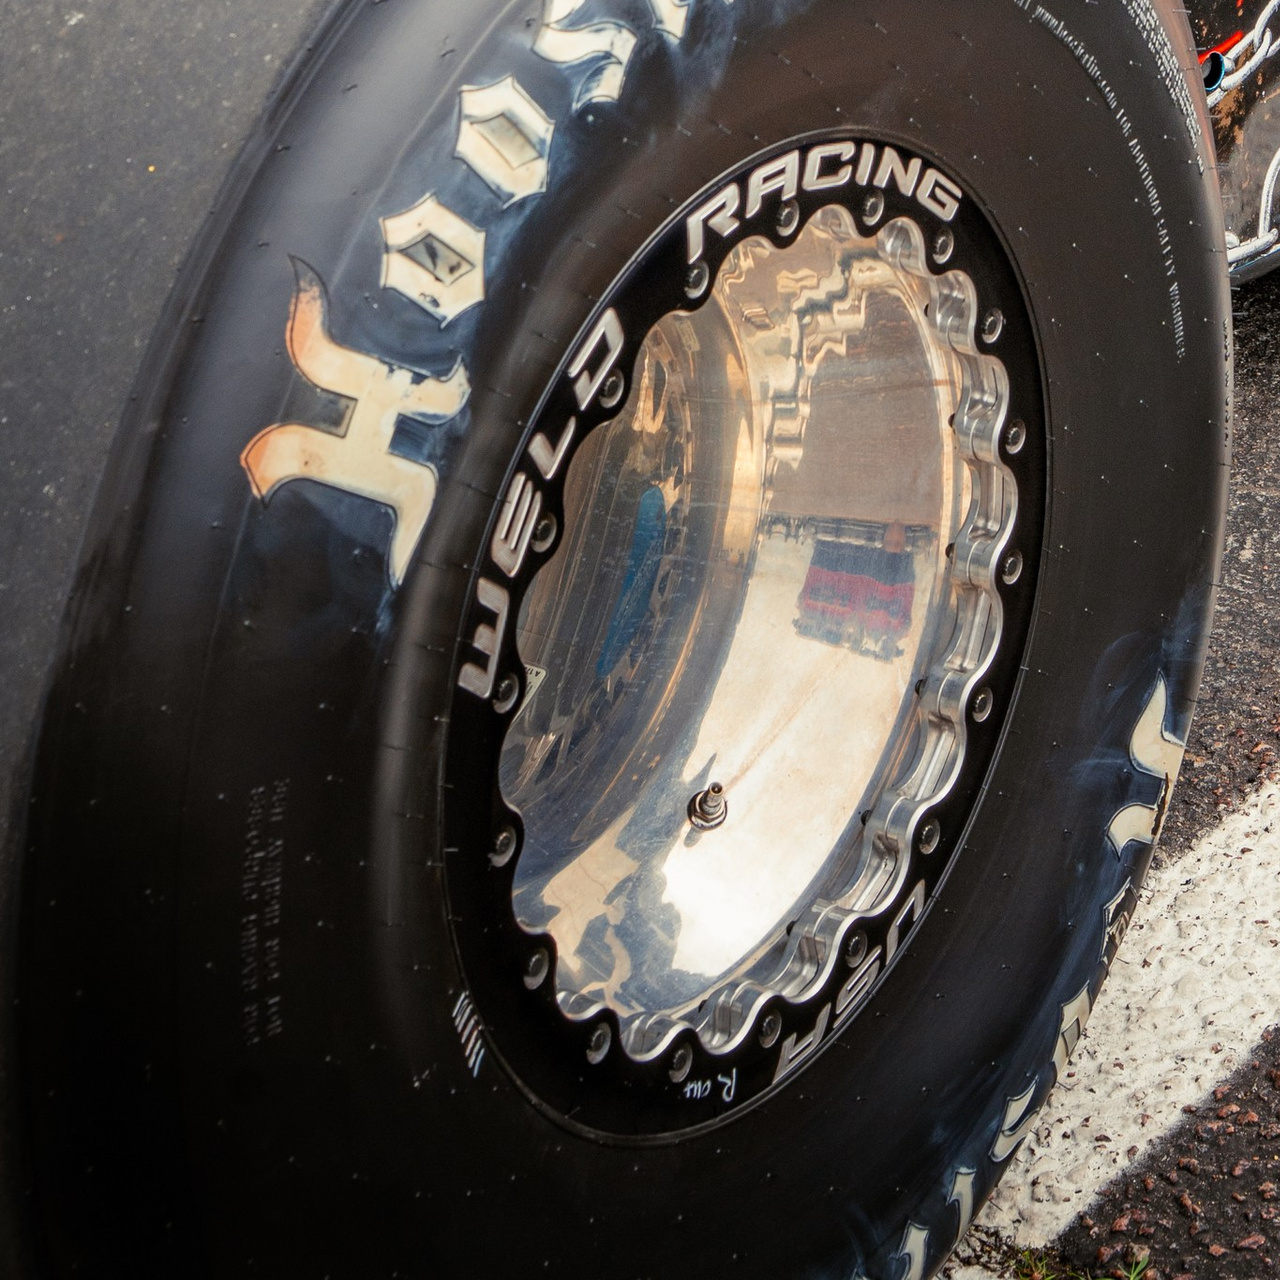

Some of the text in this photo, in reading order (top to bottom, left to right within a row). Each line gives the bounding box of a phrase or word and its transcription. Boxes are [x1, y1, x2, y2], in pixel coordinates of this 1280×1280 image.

[686, 140, 963, 261] RACING
[460, 308, 623, 697] WELD
[771, 878, 926, 1085] USA
